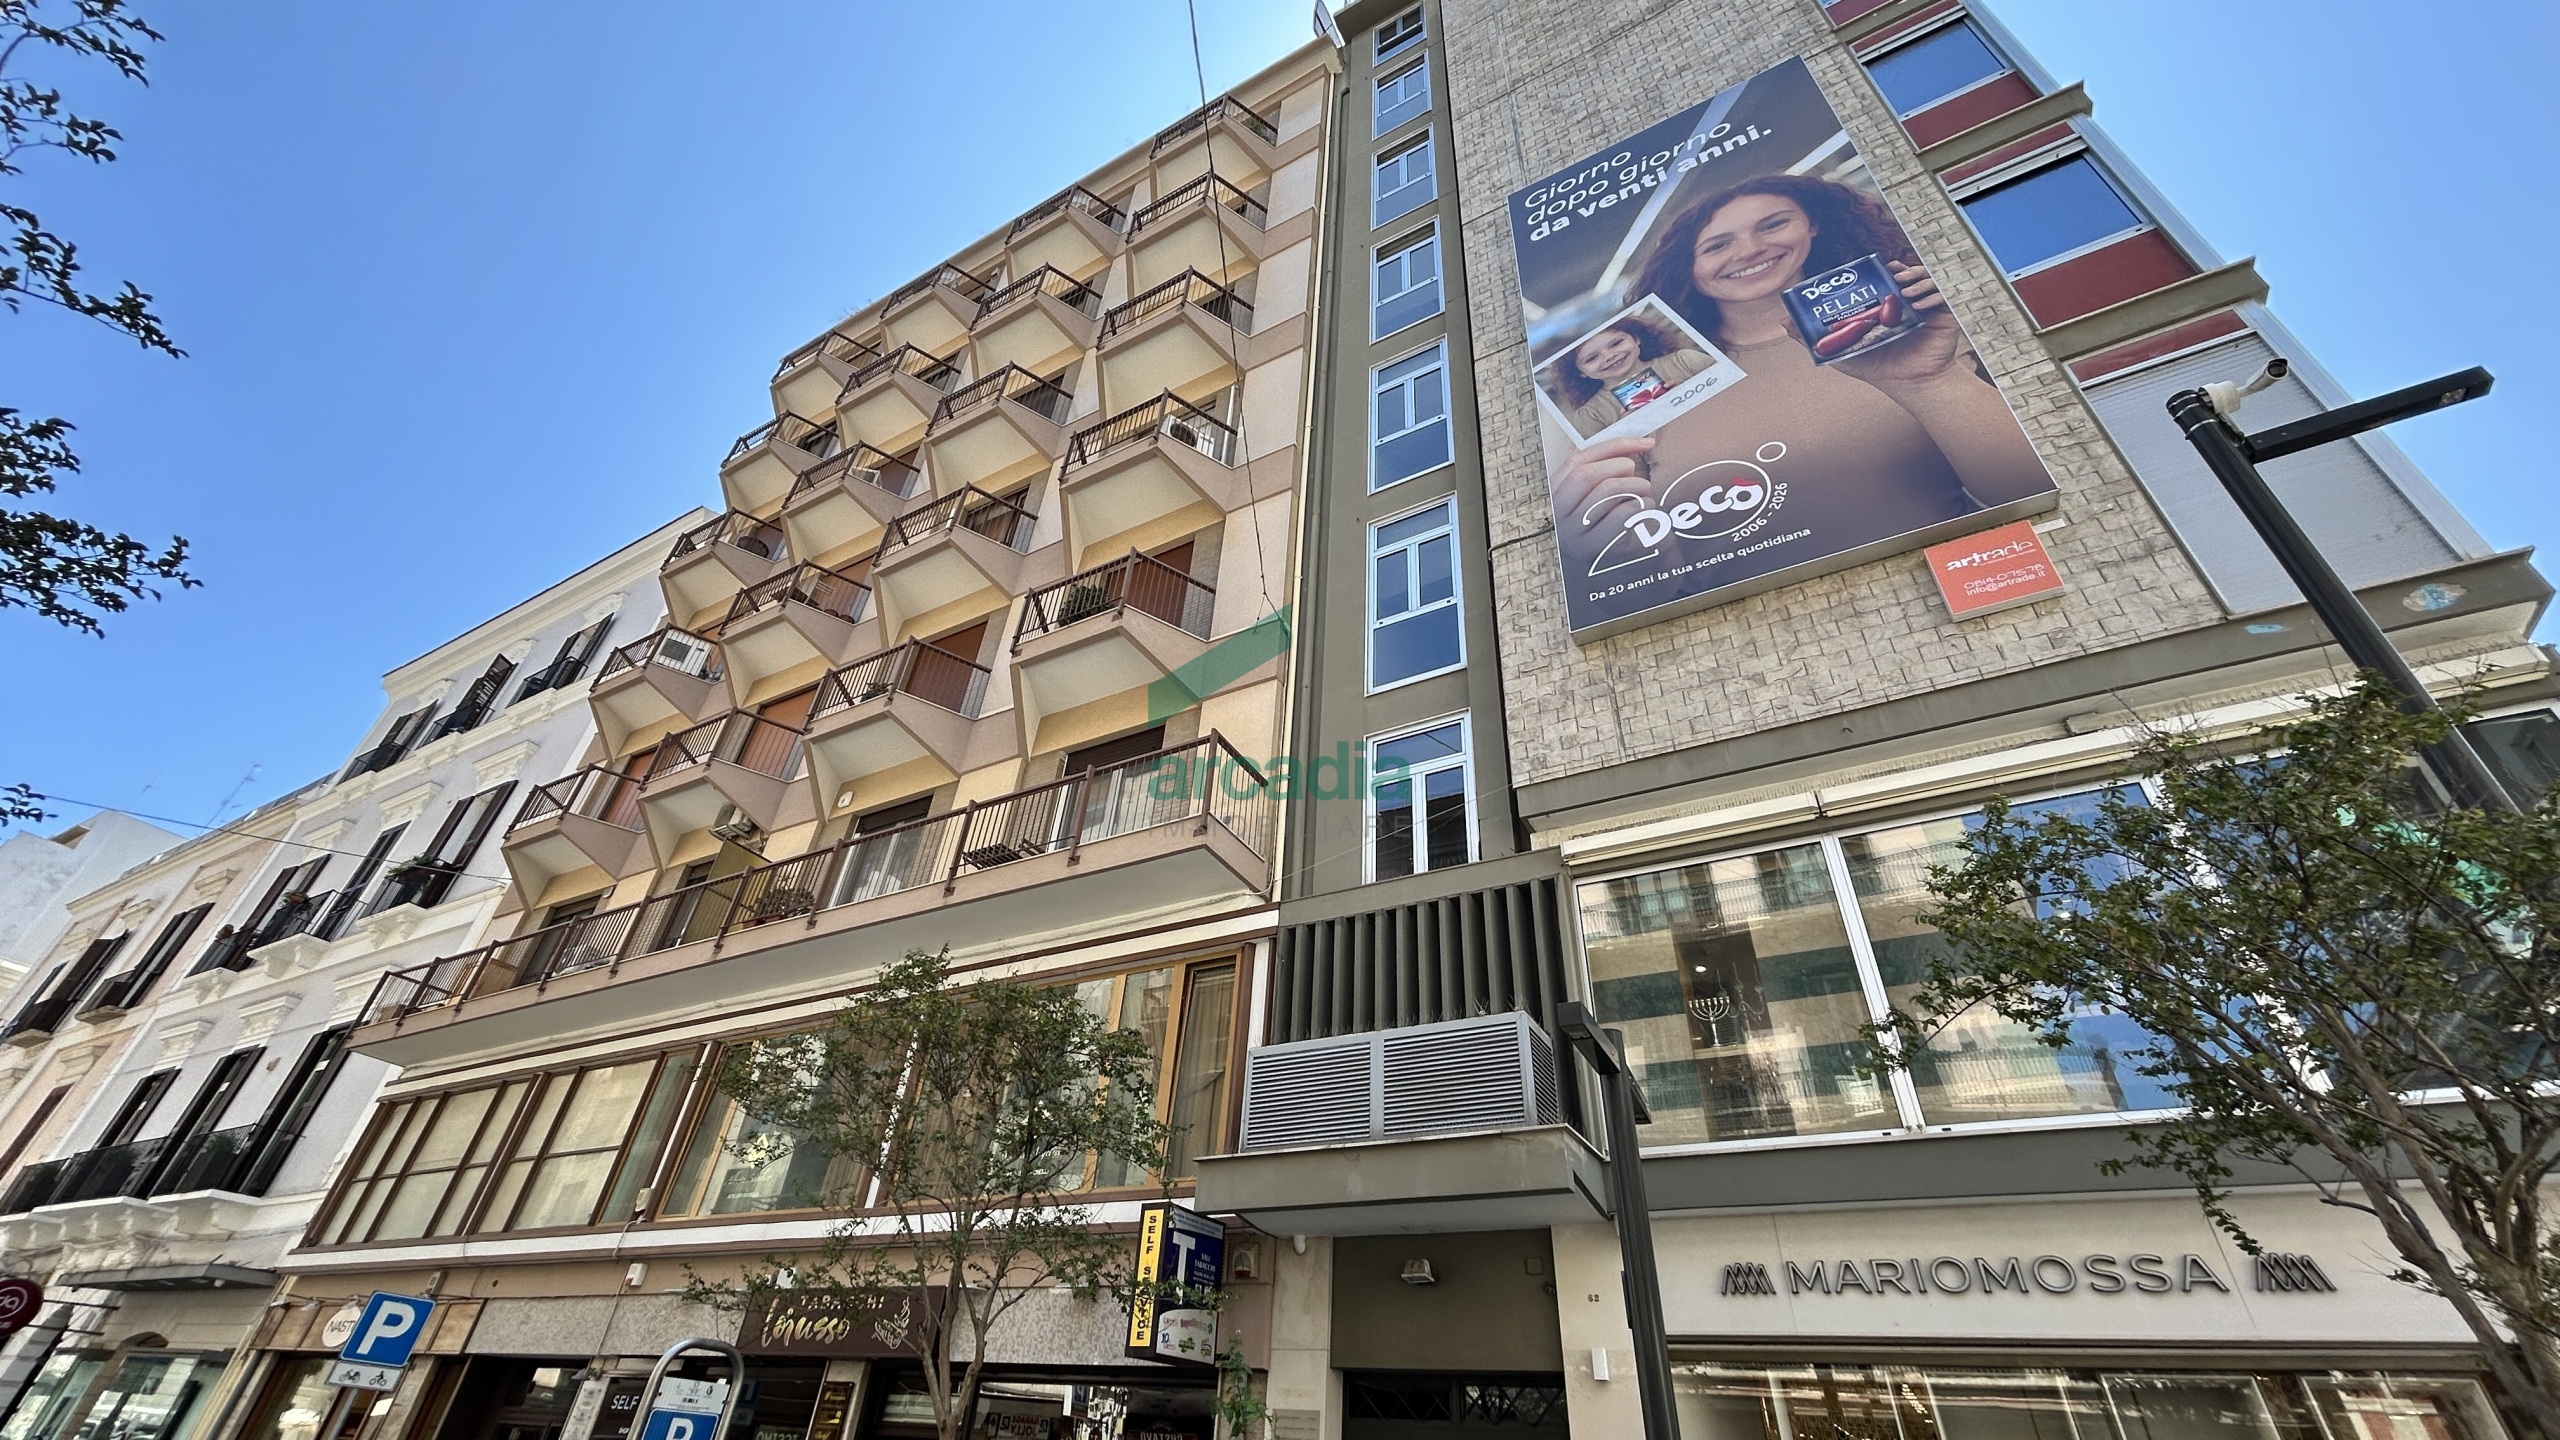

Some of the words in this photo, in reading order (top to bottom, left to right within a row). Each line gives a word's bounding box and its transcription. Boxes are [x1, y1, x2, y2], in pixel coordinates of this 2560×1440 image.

[1524, 151, 1632, 208] Giorno
[1527, 179, 1609, 226] dopo
[1618, 122, 1731, 186] giorno
[1529, 215, 1571, 242] da
[1577, 166, 1668, 218] venti
[1677, 124, 1772, 173] anni.
[1812, 284, 1878, 318] PELATI
[1670, 376, 1718, 407] 2006
[1623, 476, 1764, 548] Decò
[1730, 516, 1768, 543] 2006
[1768, 482, 1788, 510] 2026
[1589, 590, 1606, 602] Da
[1608, 583, 1625, 596] 20
[1626, 574, 1654, 591] anni
[1657, 570, 1670, 582] la
[1671, 564, 1694, 577] tua
[1695, 549, 1735, 570] scelta
[1736, 527, 1812, 557] quotidiana
[1945, 540, 2034, 571] artrade
[1966, 569, 2047, 597] info@artrade.it
[1145, 1215, 1158, 1255] SELF
[1172, 1230, 1197, 1306] T
[1784, 1253, 2232, 1297] MARIOMOSSA
[1587, 1293, 1600, 1303] 62
[356, 1300, 416, 1355] P
[610, 1395, 640, 1411] SELF
